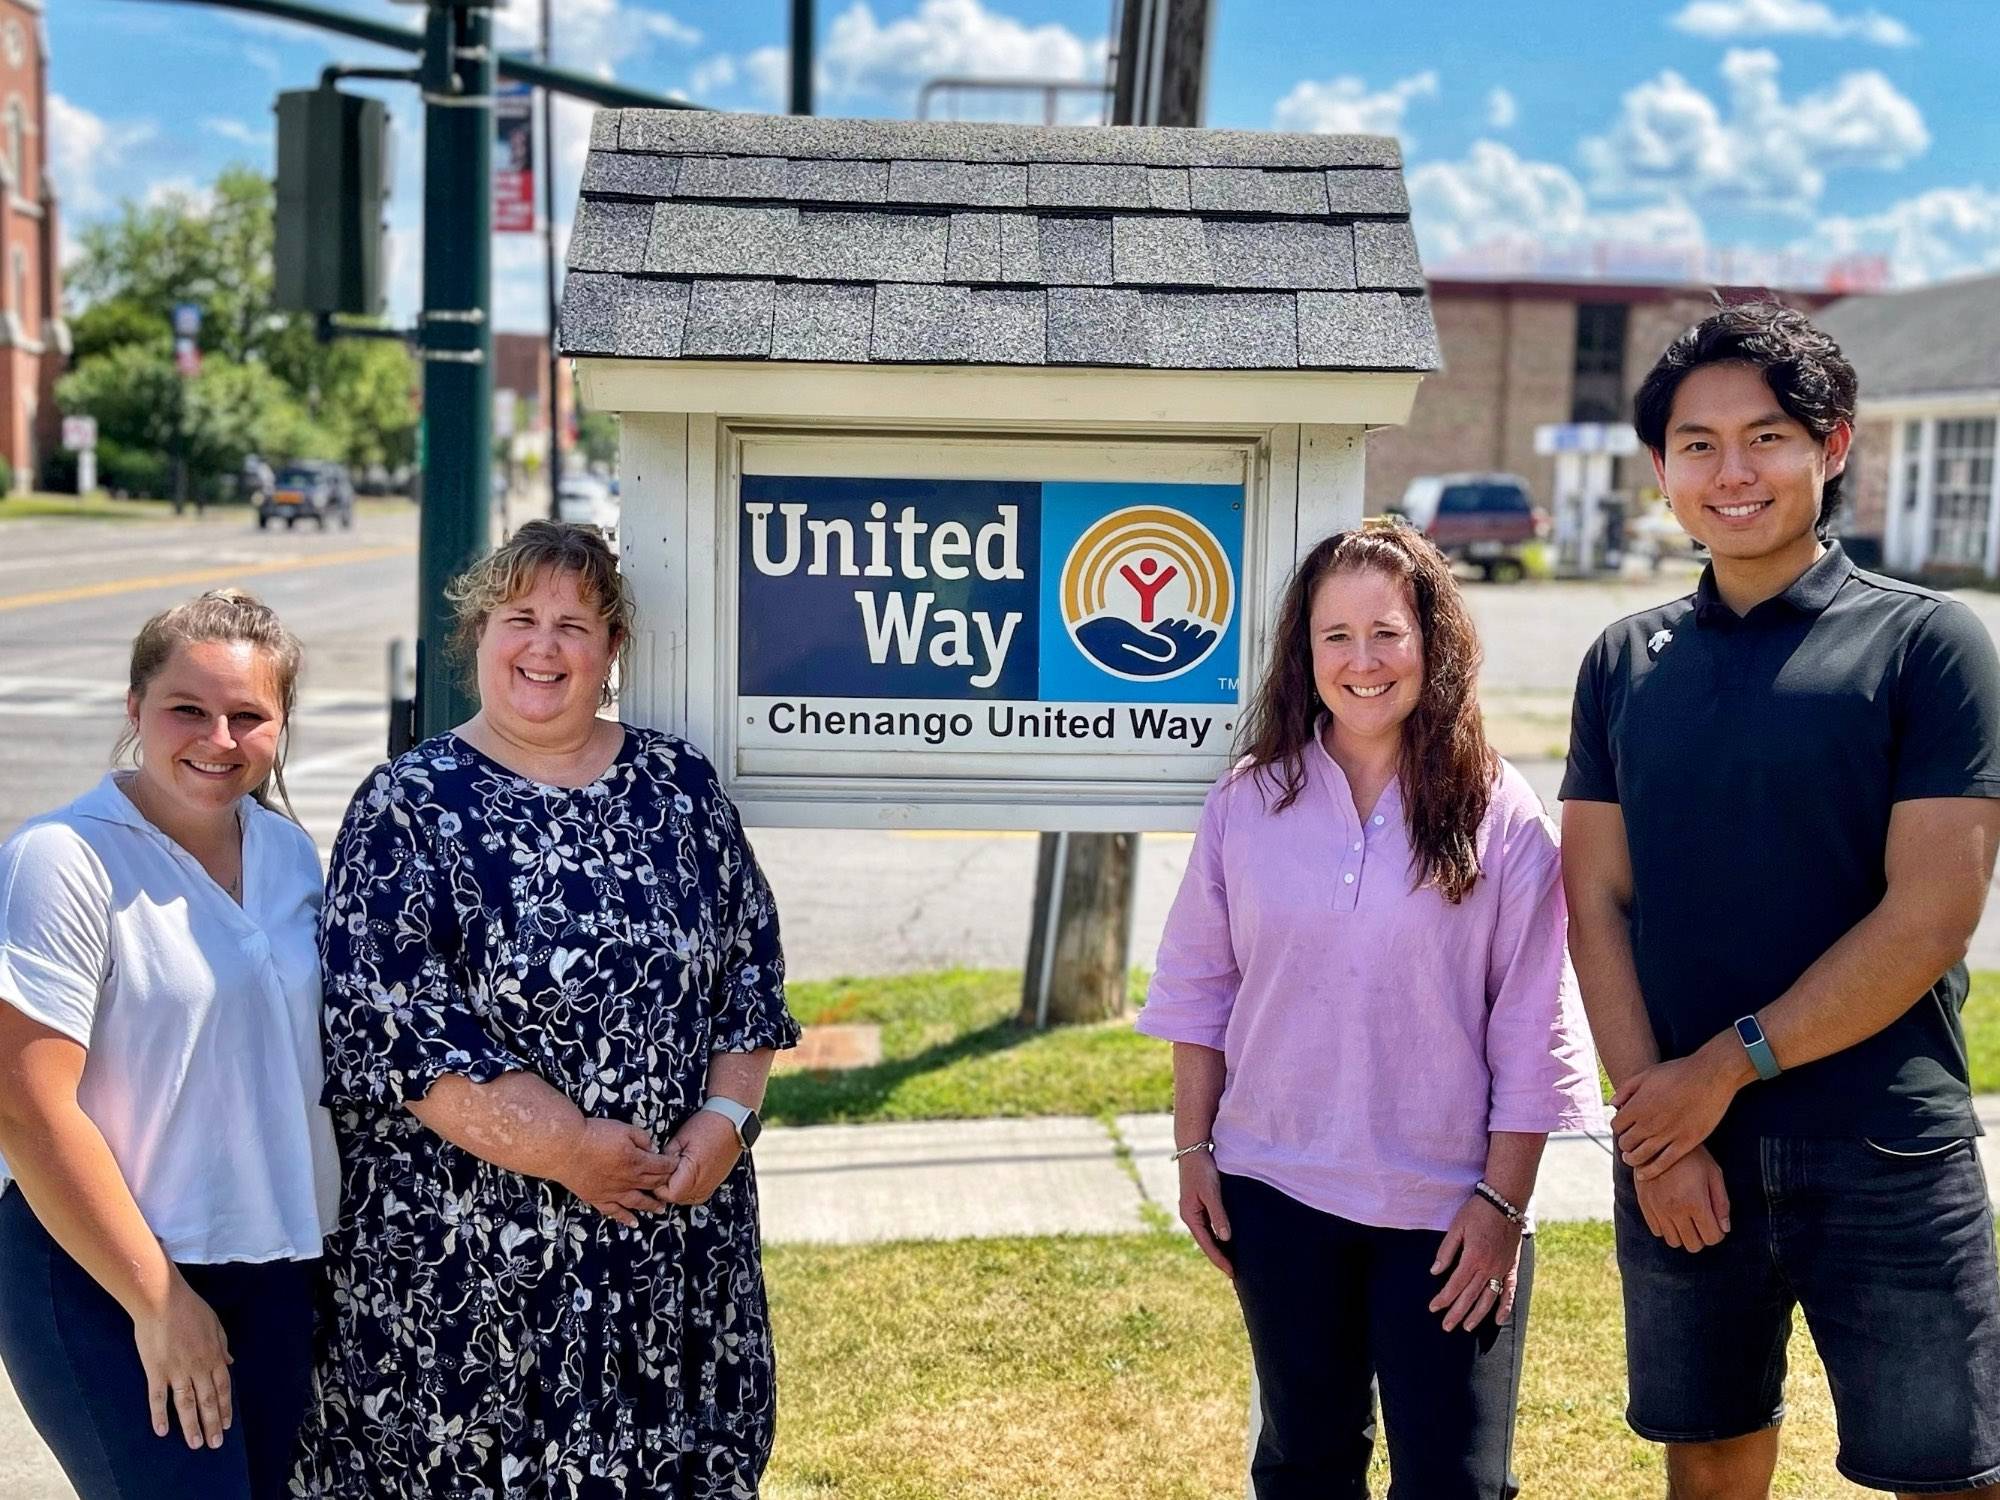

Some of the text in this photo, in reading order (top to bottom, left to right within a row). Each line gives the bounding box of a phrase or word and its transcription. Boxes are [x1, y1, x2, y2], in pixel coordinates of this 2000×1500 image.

[746, 502, 1024, 580] United
[855, 591, 1022, 688] Way
[1217, 678, 1240, 690] TM
[768, 703, 1212, 747] Chenango United Way
